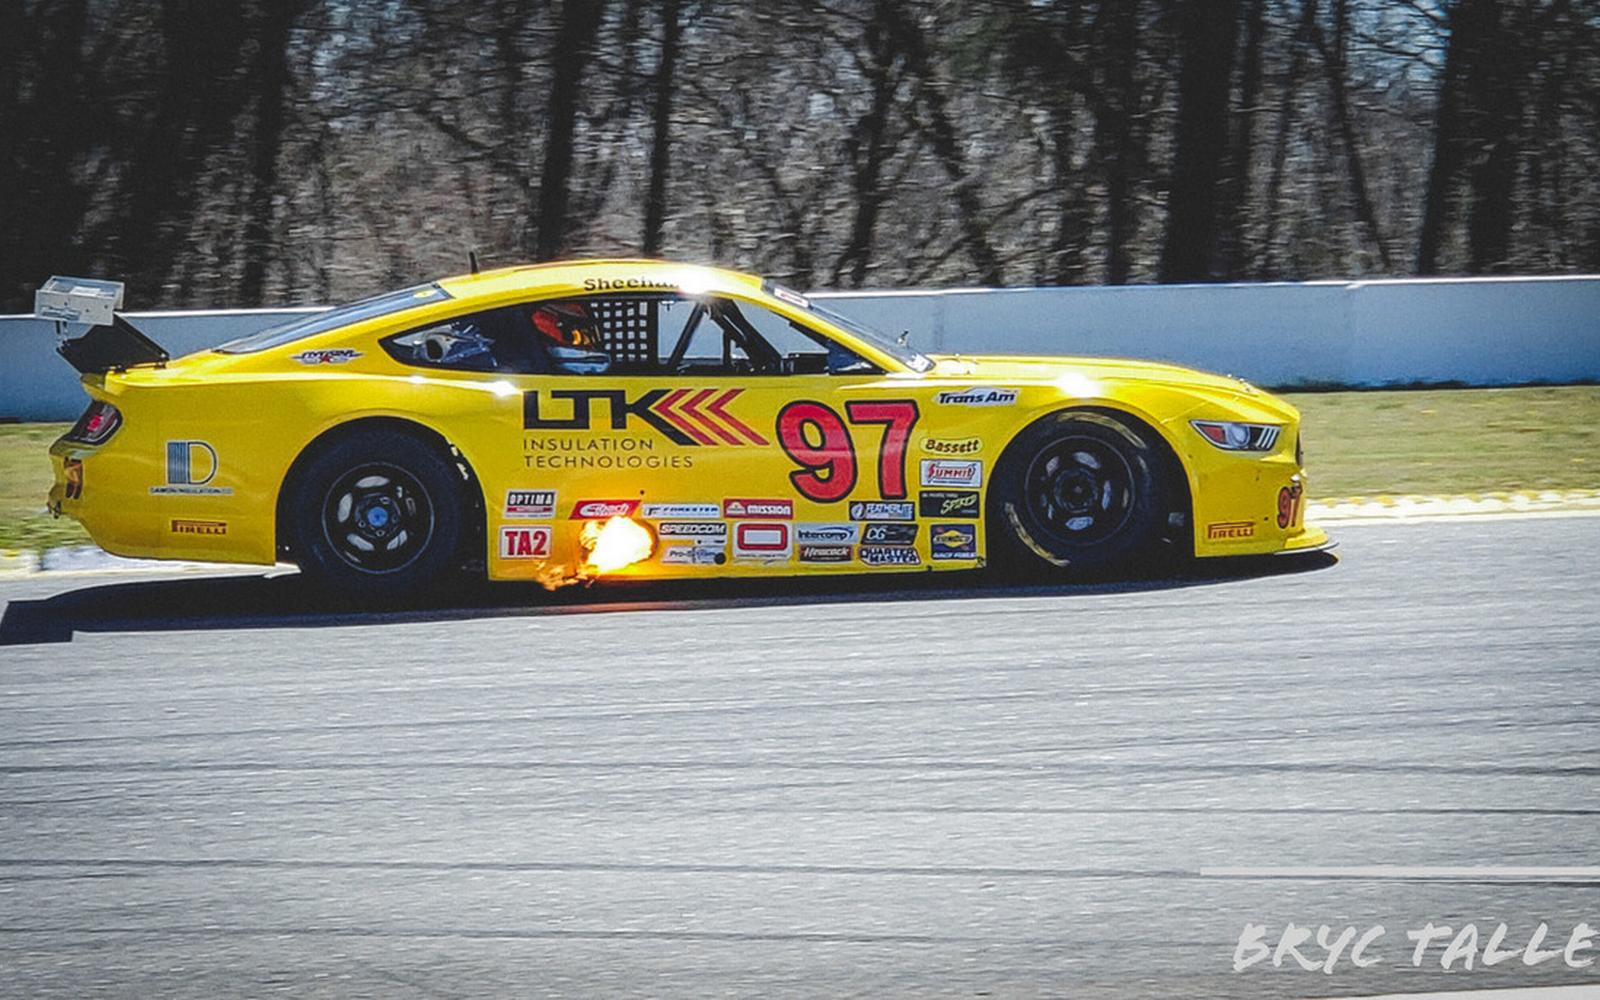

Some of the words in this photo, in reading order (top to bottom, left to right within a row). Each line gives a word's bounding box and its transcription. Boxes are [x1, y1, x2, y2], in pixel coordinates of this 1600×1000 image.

[939, 393, 984, 404] Trans
[985, 392, 1015, 402] Am
[523, 389, 700, 446] LTK
[523, 438, 653, 452] INSULATION
[776, 399, 921, 503] 97
[925, 439, 979, 453] Bassett
[523, 454, 693, 469] TECHNOLOGIES
[509, 494, 553, 505] OPTIMA
[171, 520, 227, 535] PIRELLI
[660, 524, 725, 535] SPEEDCOM
[798, 529, 847, 540] Intercomp
[1207, 521, 1256, 539] PIRELLI
[505, 530, 548, 556] TA2
